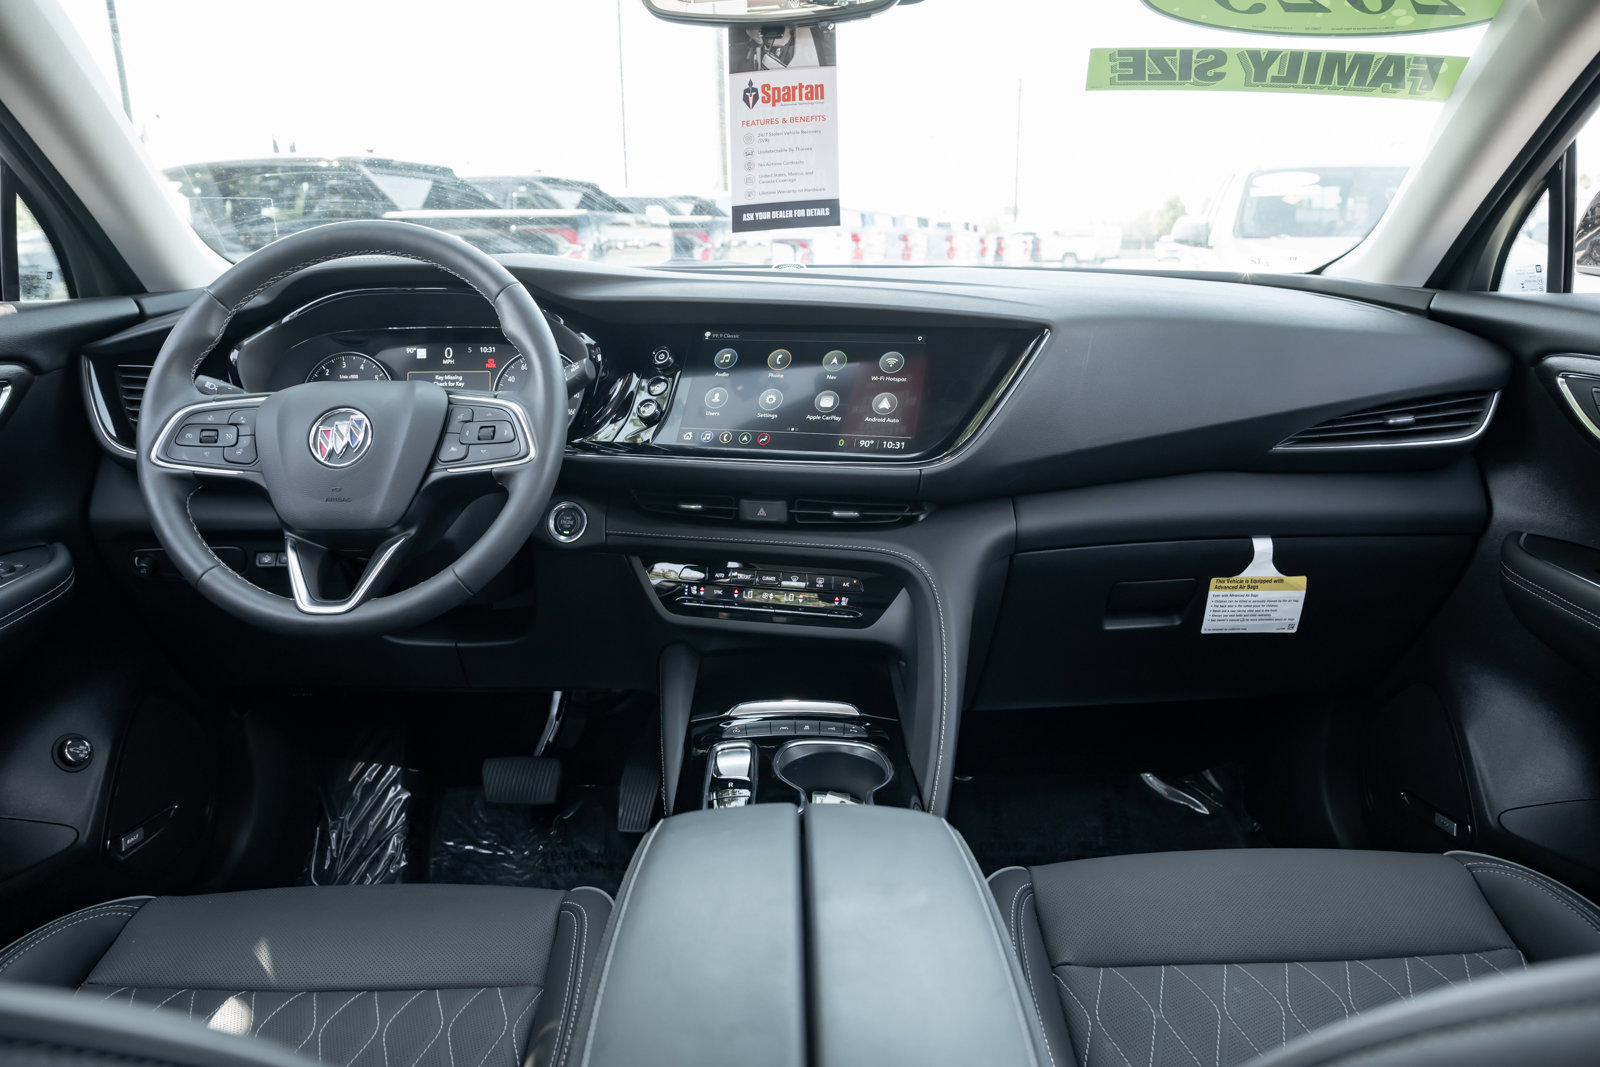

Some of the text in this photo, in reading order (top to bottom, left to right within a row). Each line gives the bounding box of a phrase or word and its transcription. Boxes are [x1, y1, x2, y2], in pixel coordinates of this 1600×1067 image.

[761, 83, 824, 107] Spartan
[741, 117, 779, 127] FEATURES
[790, 115, 826, 123] BENEFITS
[742, 208, 830, 221] ASK YOUR DEALER FOR DETAILS
[444, 347, 452, 358] 0
[784, 593, 794, 602] LO
